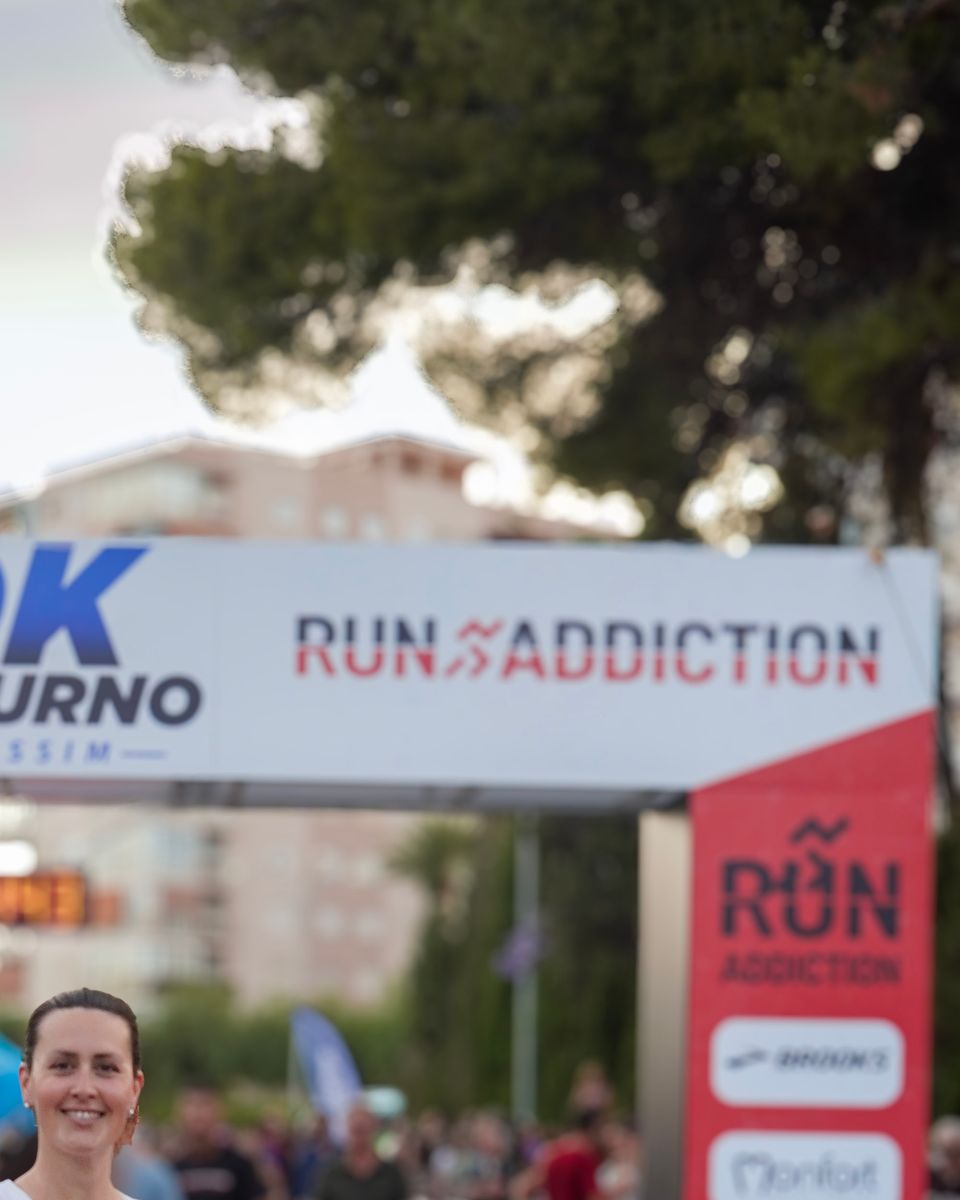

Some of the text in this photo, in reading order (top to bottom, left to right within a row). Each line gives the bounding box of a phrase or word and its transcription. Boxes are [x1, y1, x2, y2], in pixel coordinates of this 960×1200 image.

[295, 615, 880, 687] RUN ADDICTION
[720, 954, 902, 986] ADDICTION
